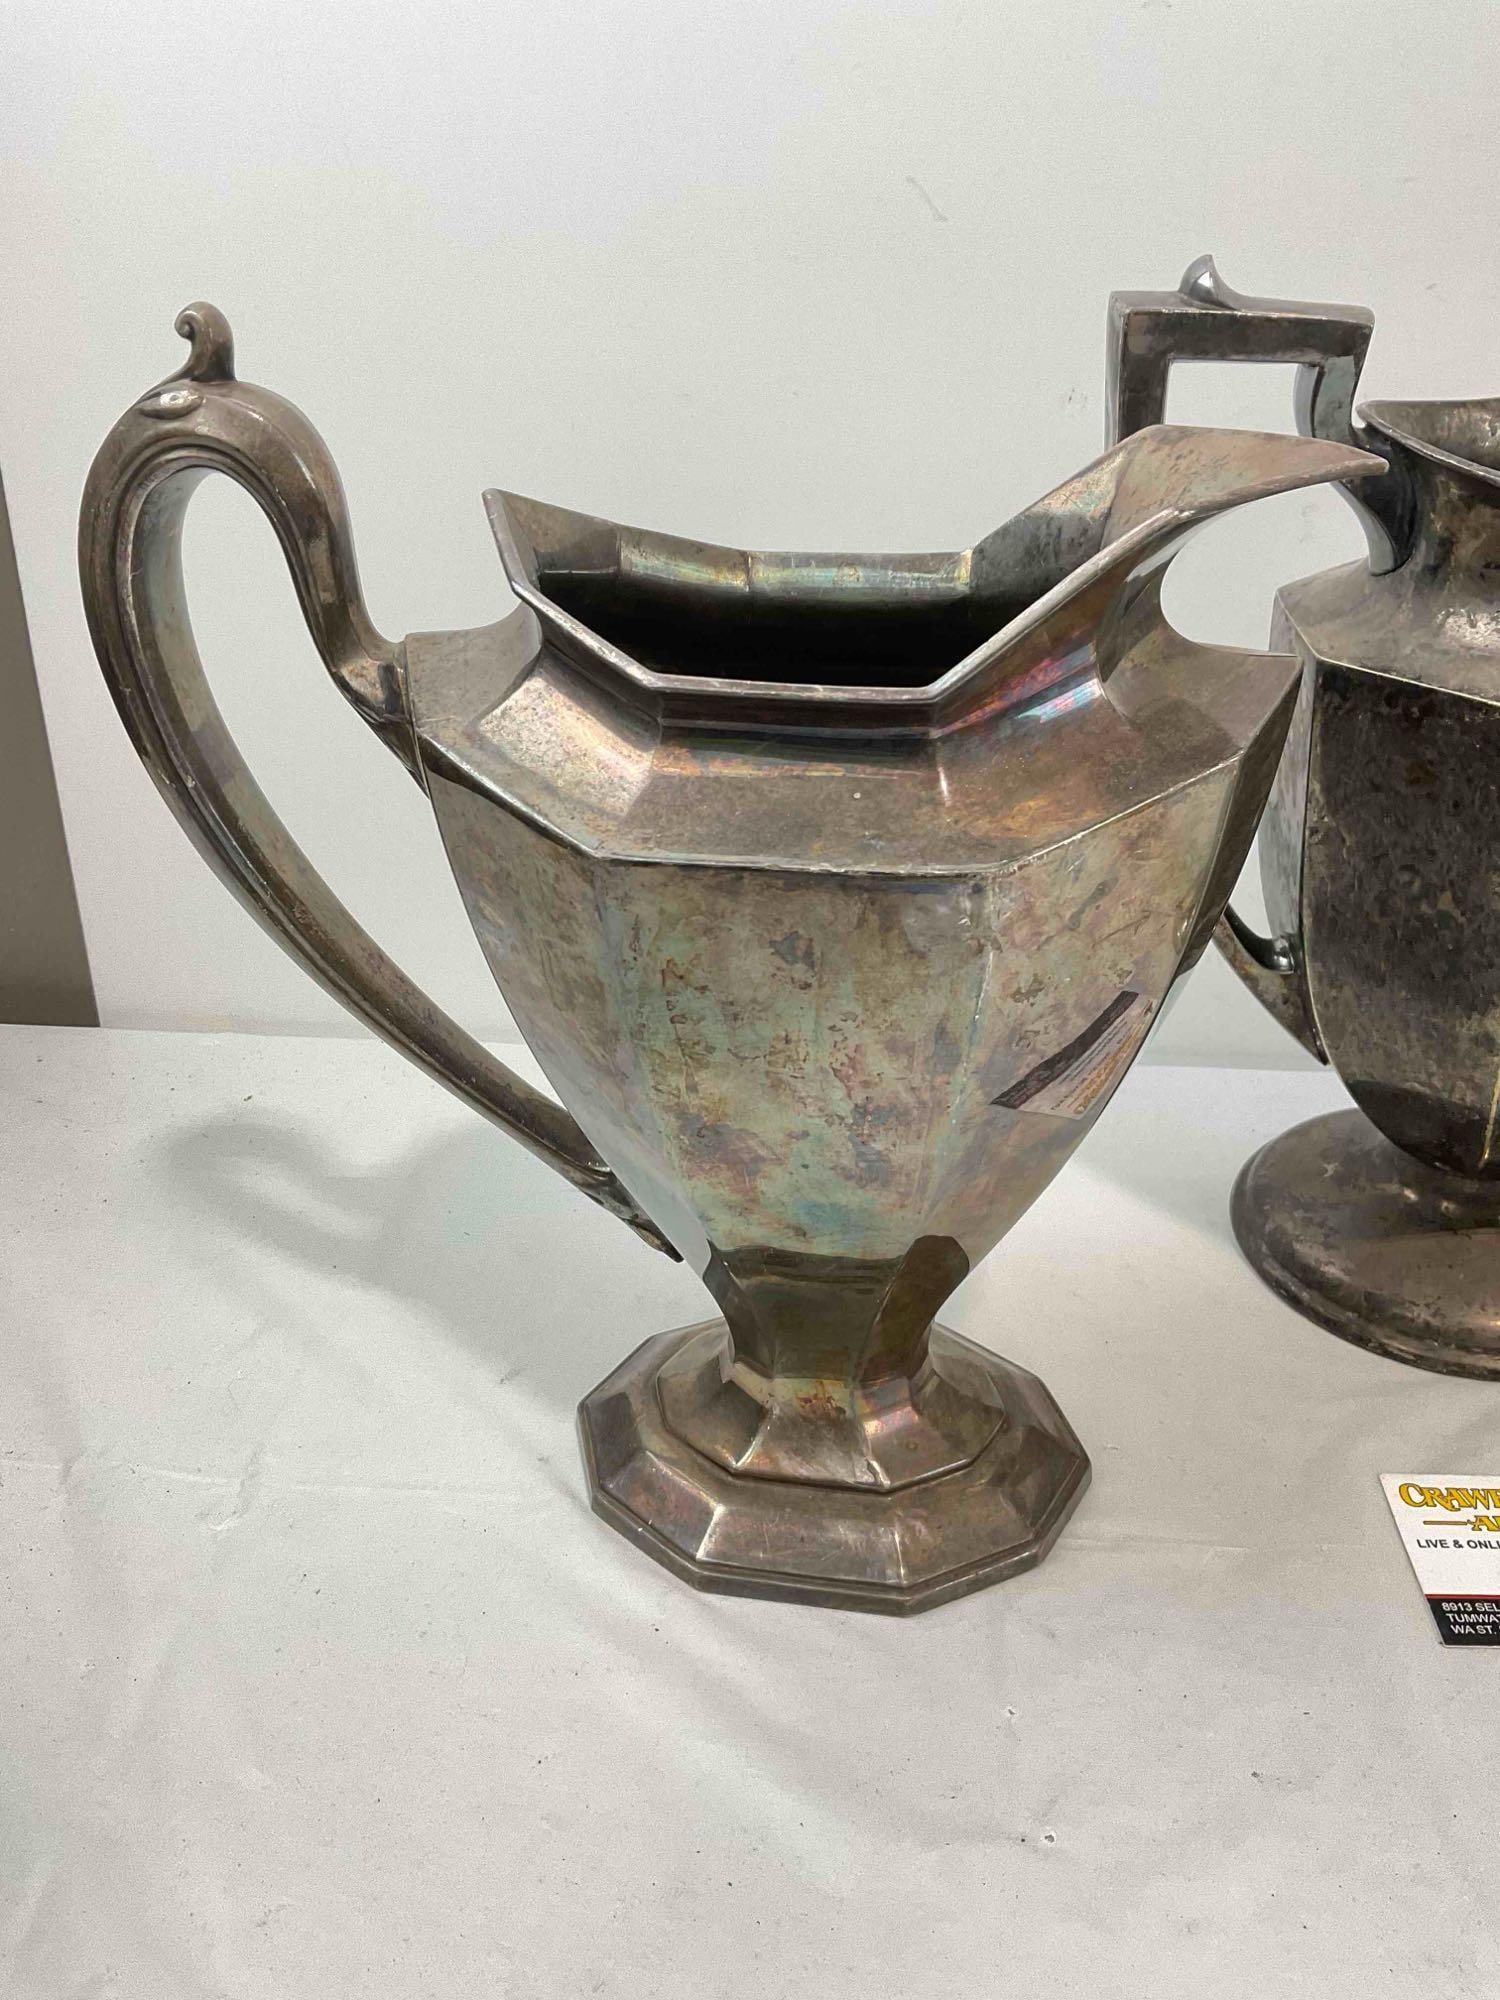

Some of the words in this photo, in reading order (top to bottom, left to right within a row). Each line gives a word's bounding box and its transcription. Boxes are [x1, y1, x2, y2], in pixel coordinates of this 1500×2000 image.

[1417, 1539, 1450, 1549] LIVE
[1453, 1539, 1464, 1549] &
[1442, 1602, 1473, 1611] 8913
[1450, 1625, 1475, 1634] WA
